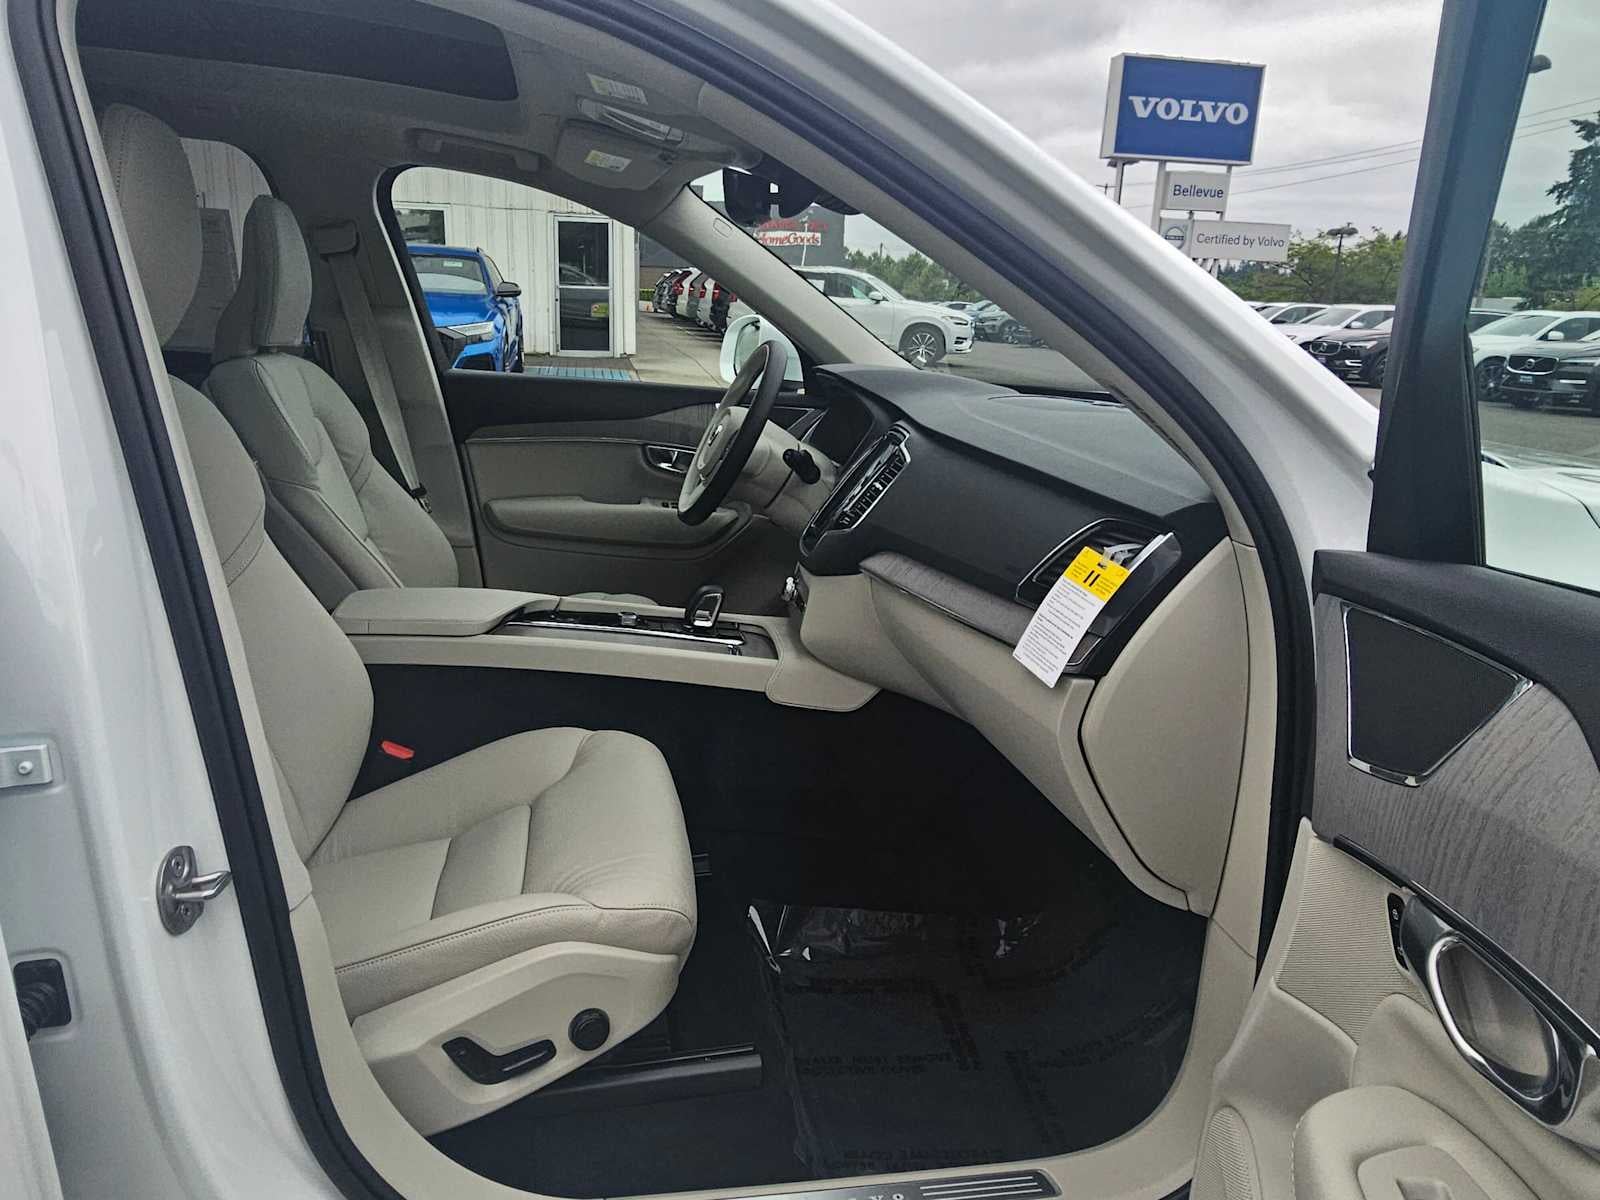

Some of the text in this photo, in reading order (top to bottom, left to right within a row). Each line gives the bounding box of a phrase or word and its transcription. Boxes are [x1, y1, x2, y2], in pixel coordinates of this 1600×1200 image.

[1129, 96, 1248, 125] VOLVO
[1173, 184, 1224, 198] Bellevue
[1196, 233, 1240, 246] Certified
[1243, 236, 1254, 248] by
[1258, 237, 1285, 248] Volvo
